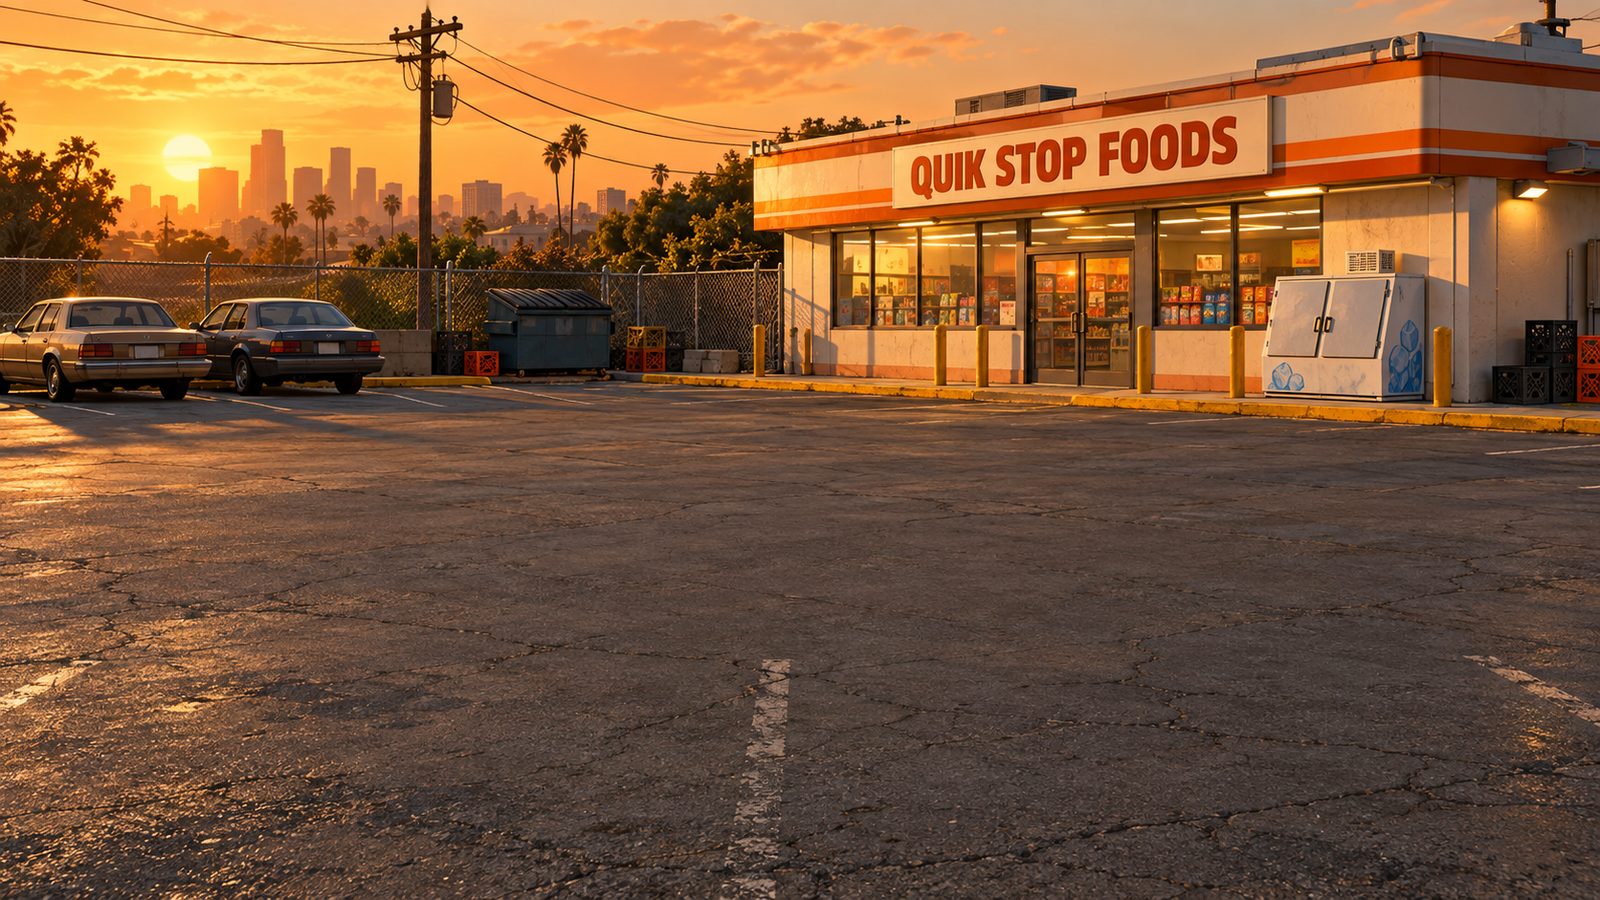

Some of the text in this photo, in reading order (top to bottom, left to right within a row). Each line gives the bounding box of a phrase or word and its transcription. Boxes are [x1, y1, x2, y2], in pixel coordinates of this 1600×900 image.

[911, 116, 1238, 200] QUIK STOP FOODS
